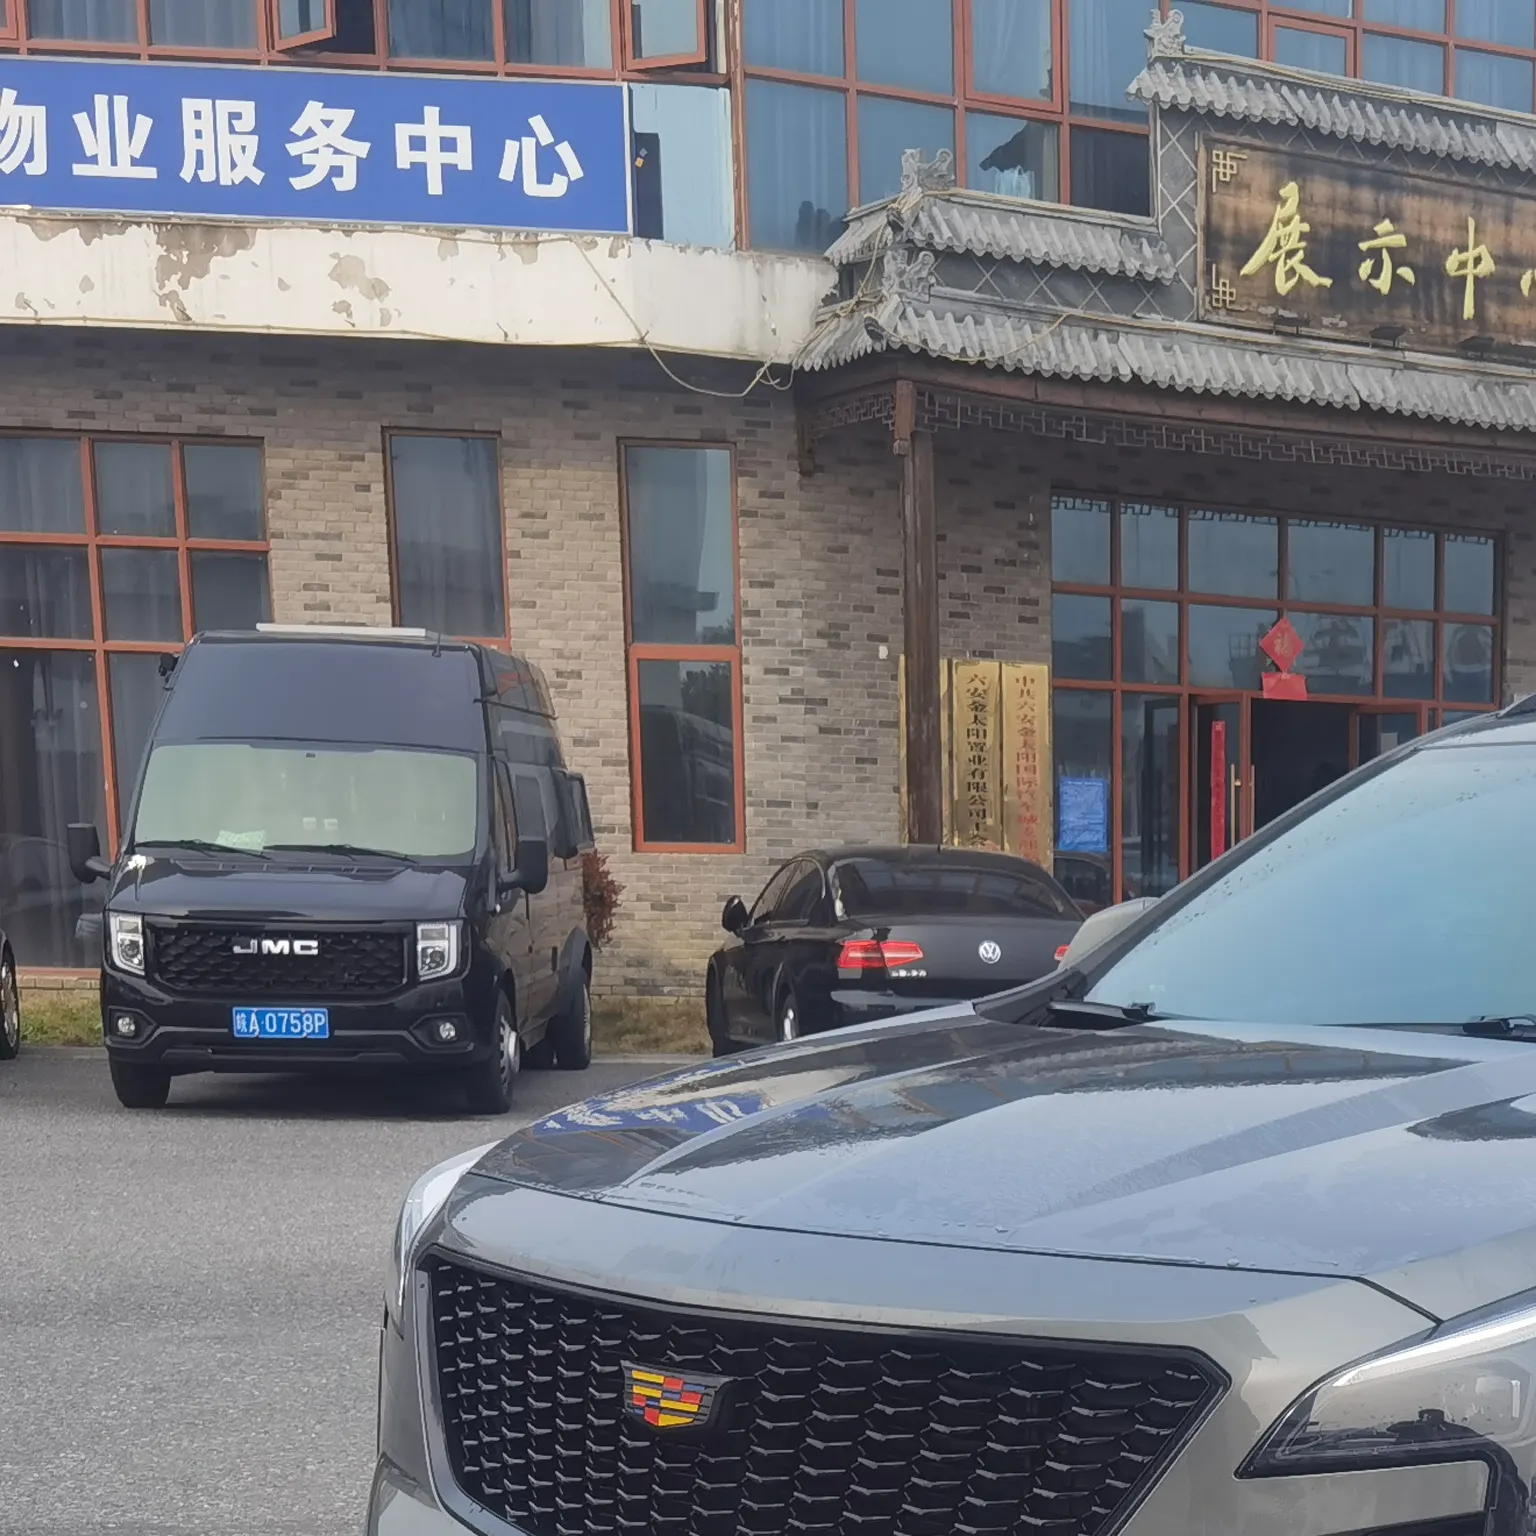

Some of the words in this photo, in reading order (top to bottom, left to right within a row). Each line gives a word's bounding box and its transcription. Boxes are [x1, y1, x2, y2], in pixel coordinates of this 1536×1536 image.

[0, 87, 584, 198] 物业服务中心
[233, 938, 319, 956] JMC
